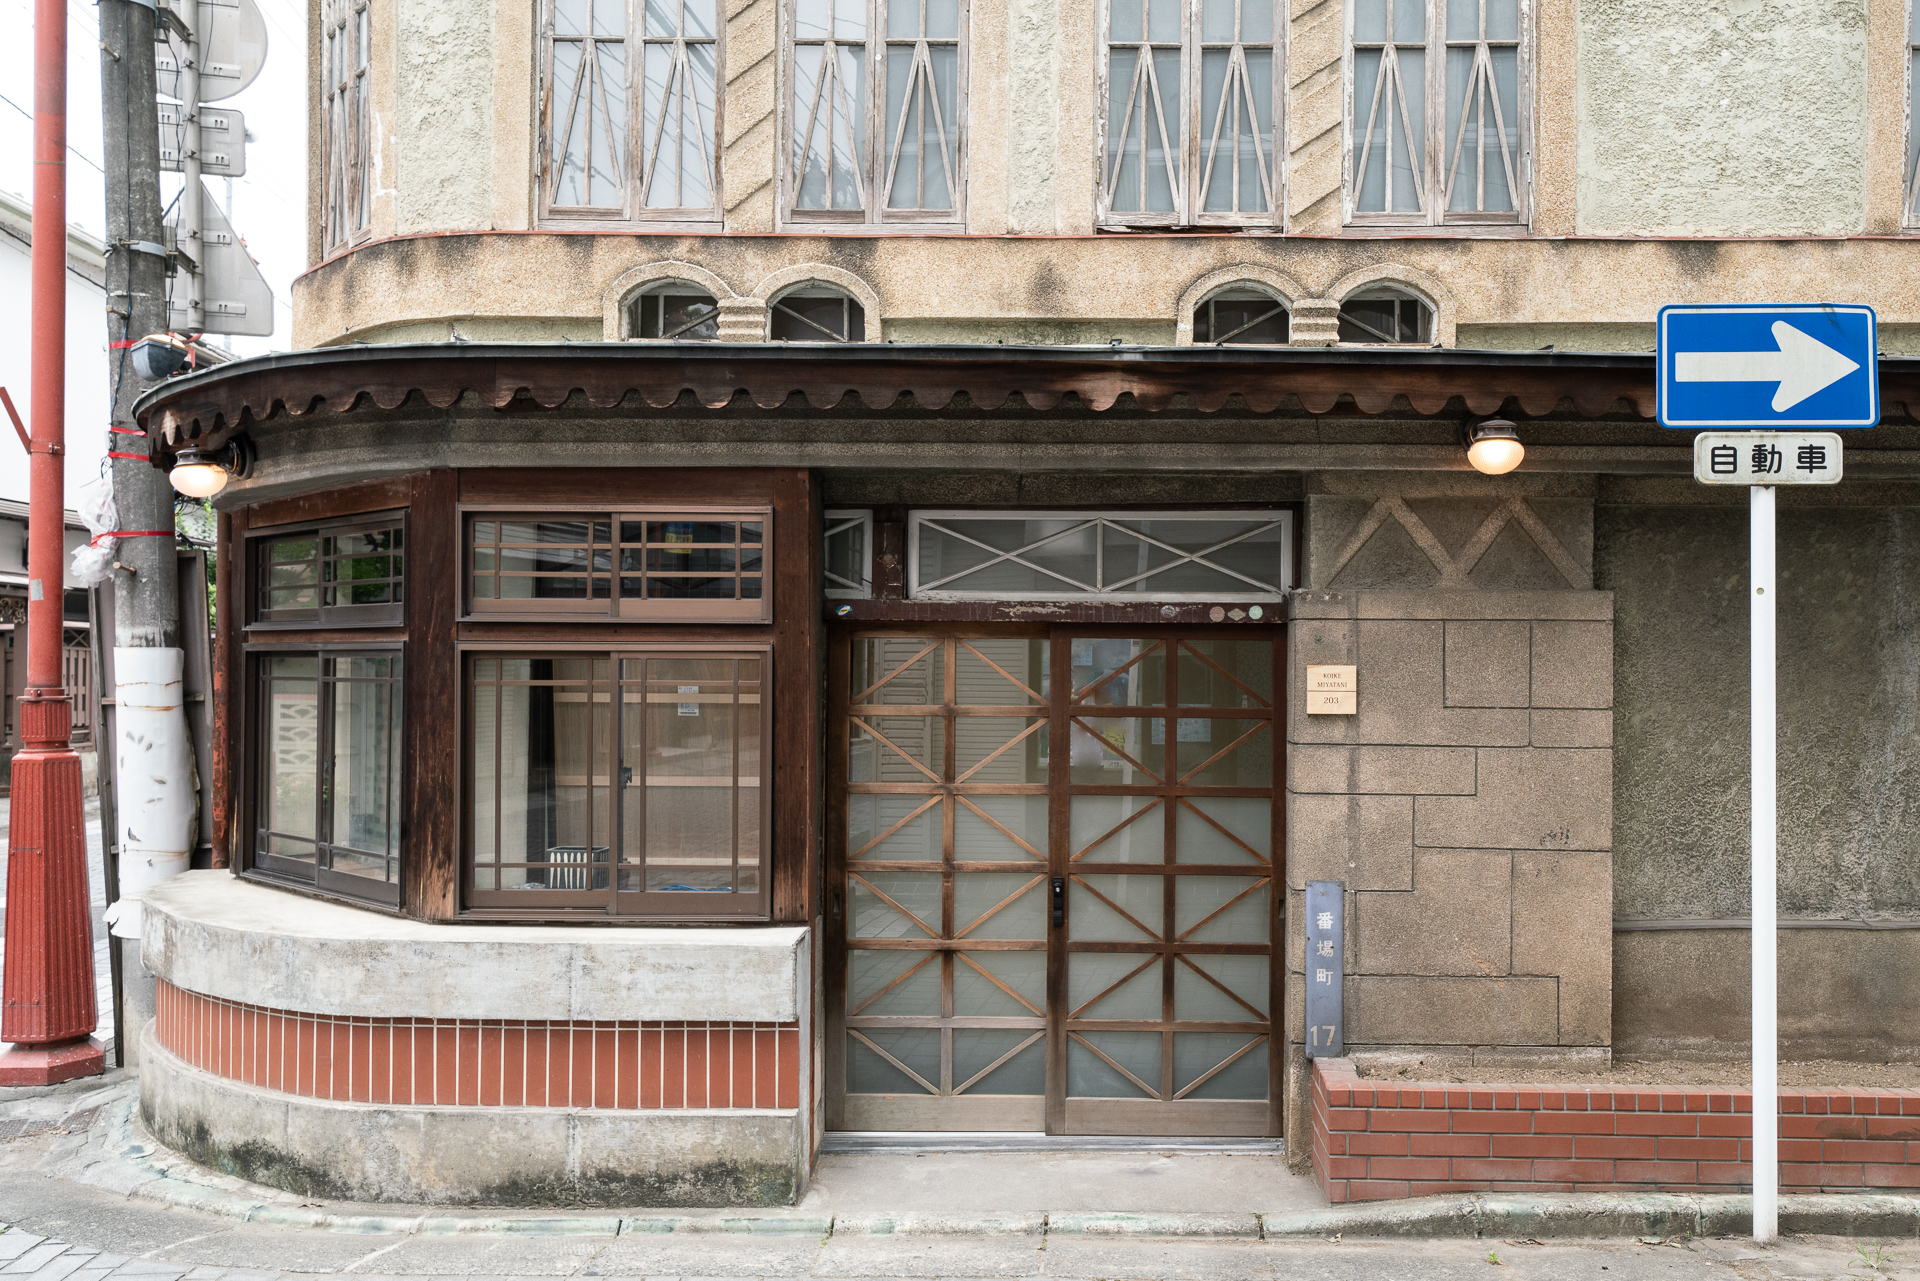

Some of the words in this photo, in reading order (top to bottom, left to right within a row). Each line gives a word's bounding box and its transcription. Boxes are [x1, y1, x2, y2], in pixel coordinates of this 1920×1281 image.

[1711, 444, 1828, 474] 自動車
[1316, 912, 1333, 986] 番場町
[1310, 1025, 1335, 1047] 17
